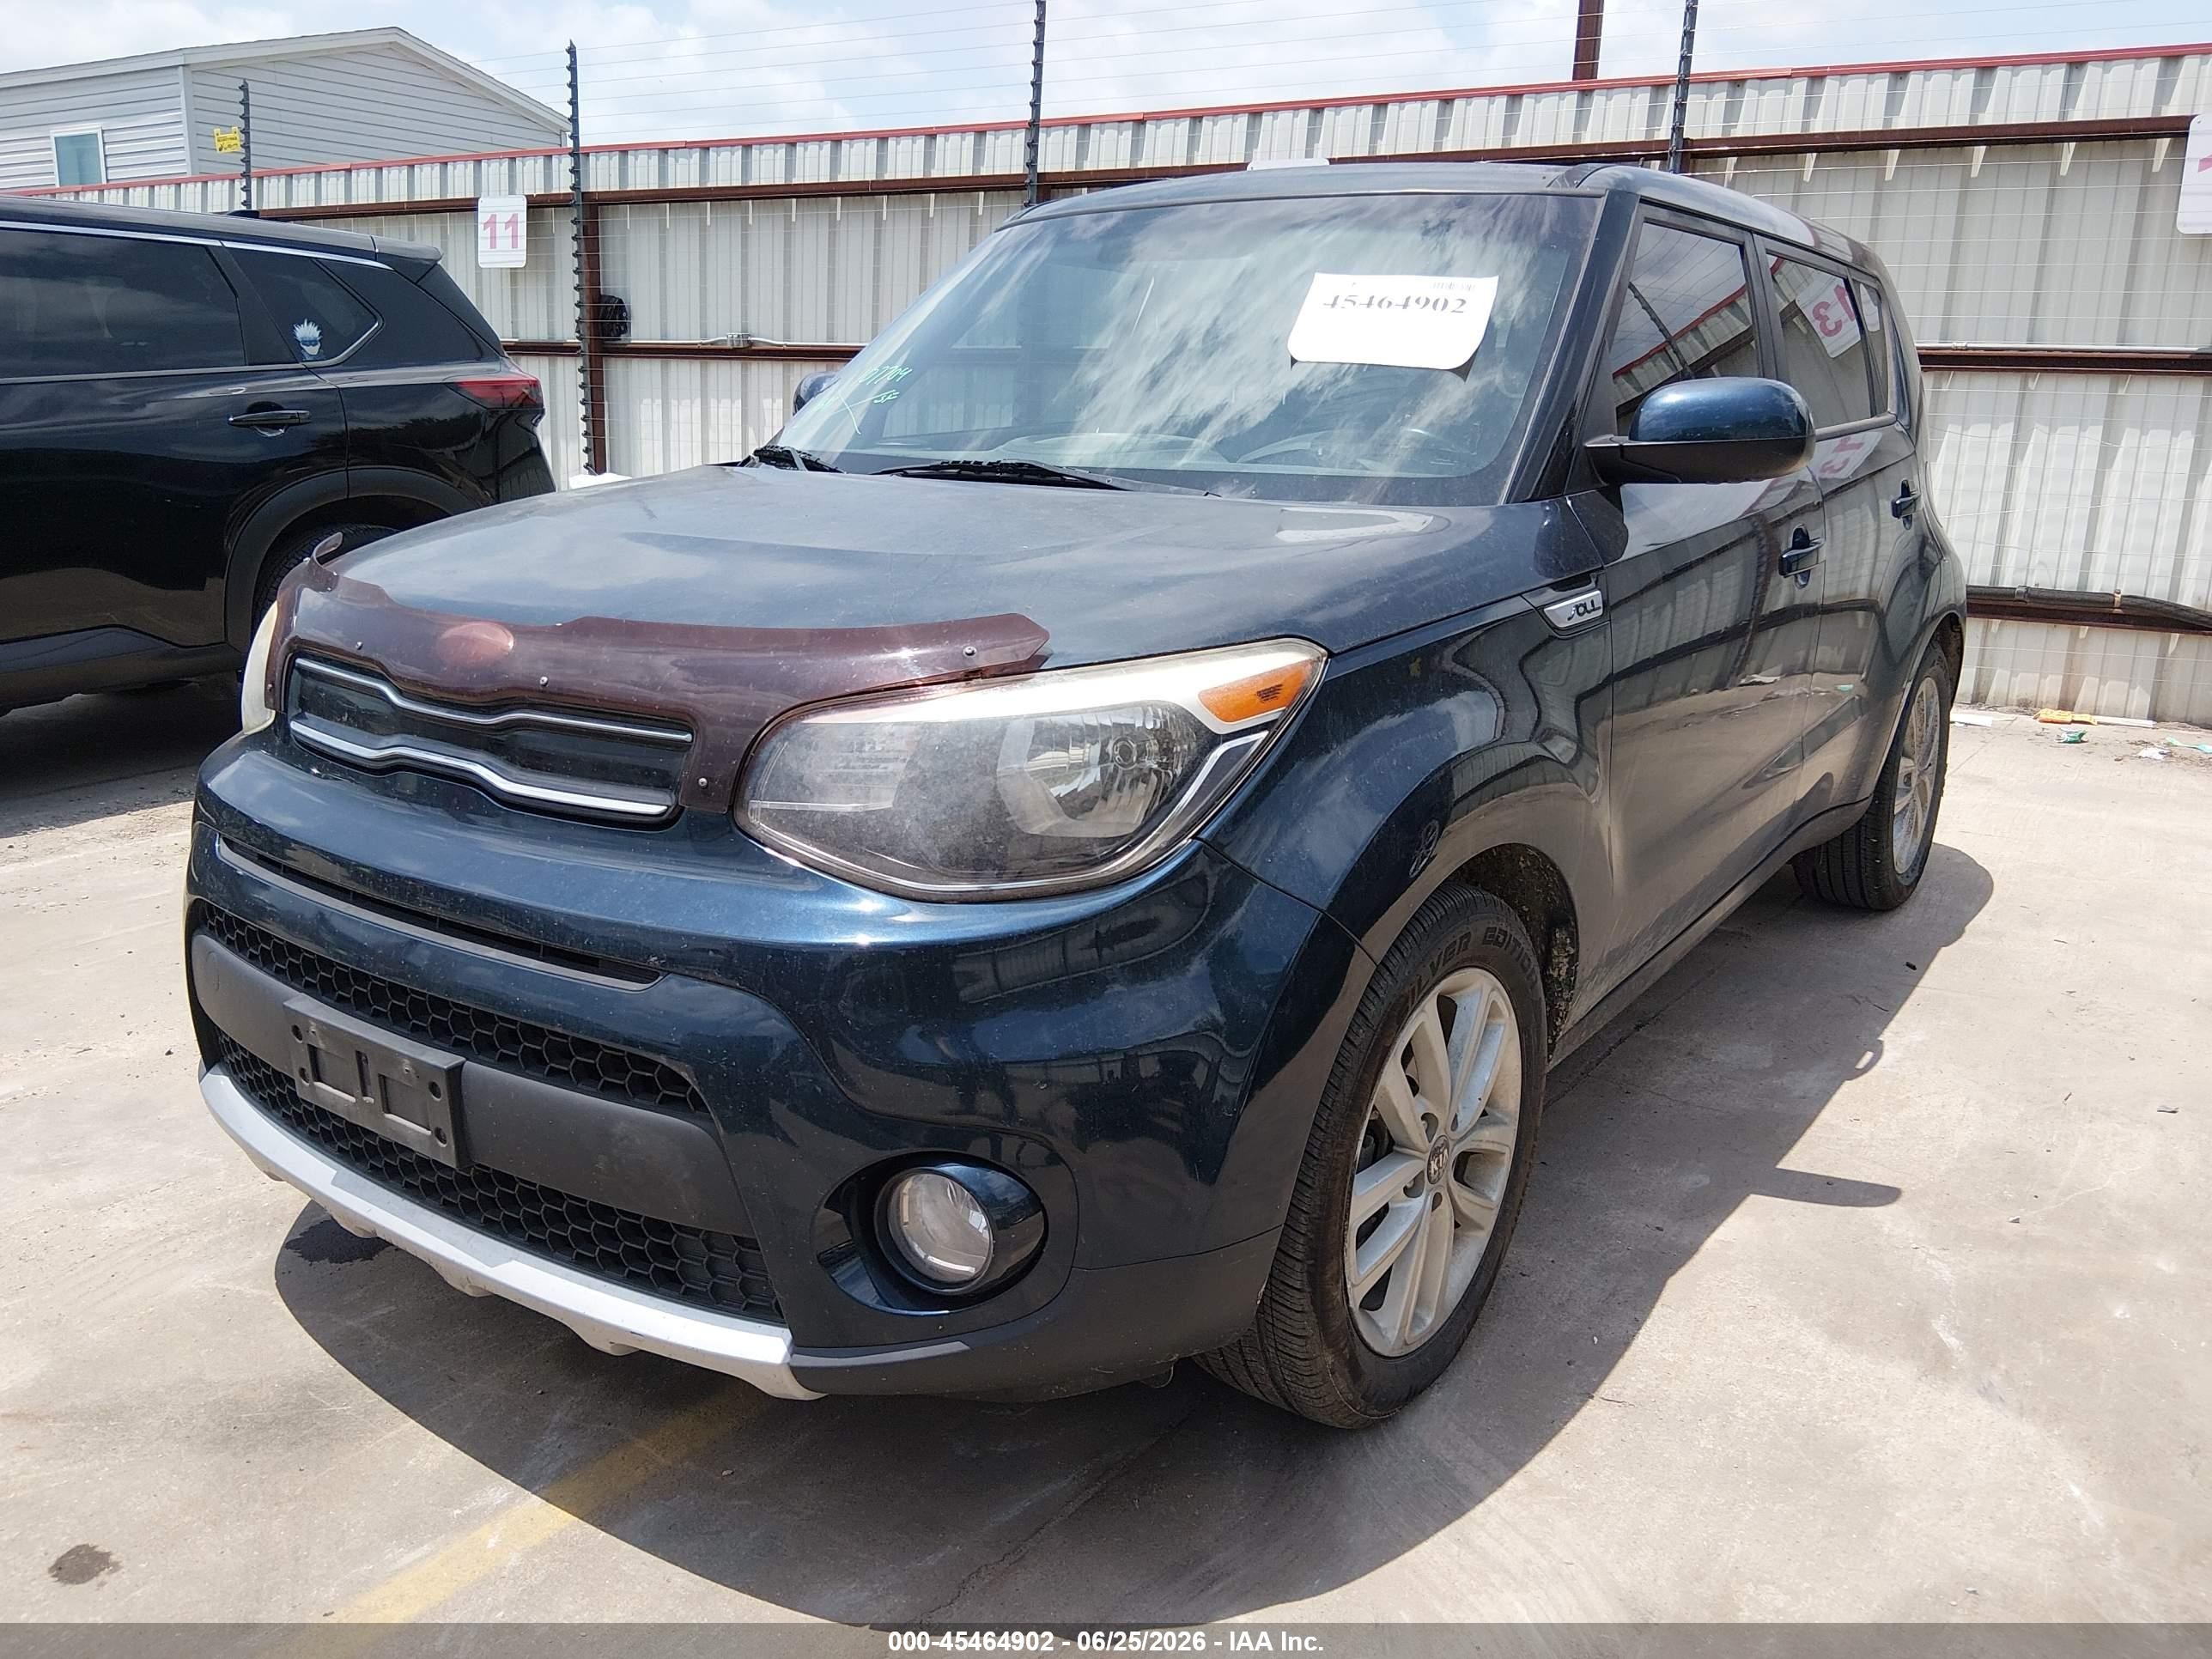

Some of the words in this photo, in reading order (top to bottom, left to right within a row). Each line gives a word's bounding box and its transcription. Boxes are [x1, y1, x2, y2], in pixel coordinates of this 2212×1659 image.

[483, 212, 519, 249] 11
[1322, 295, 1467, 313] 45464902
[1430, 1148, 1449, 1176] KIA
